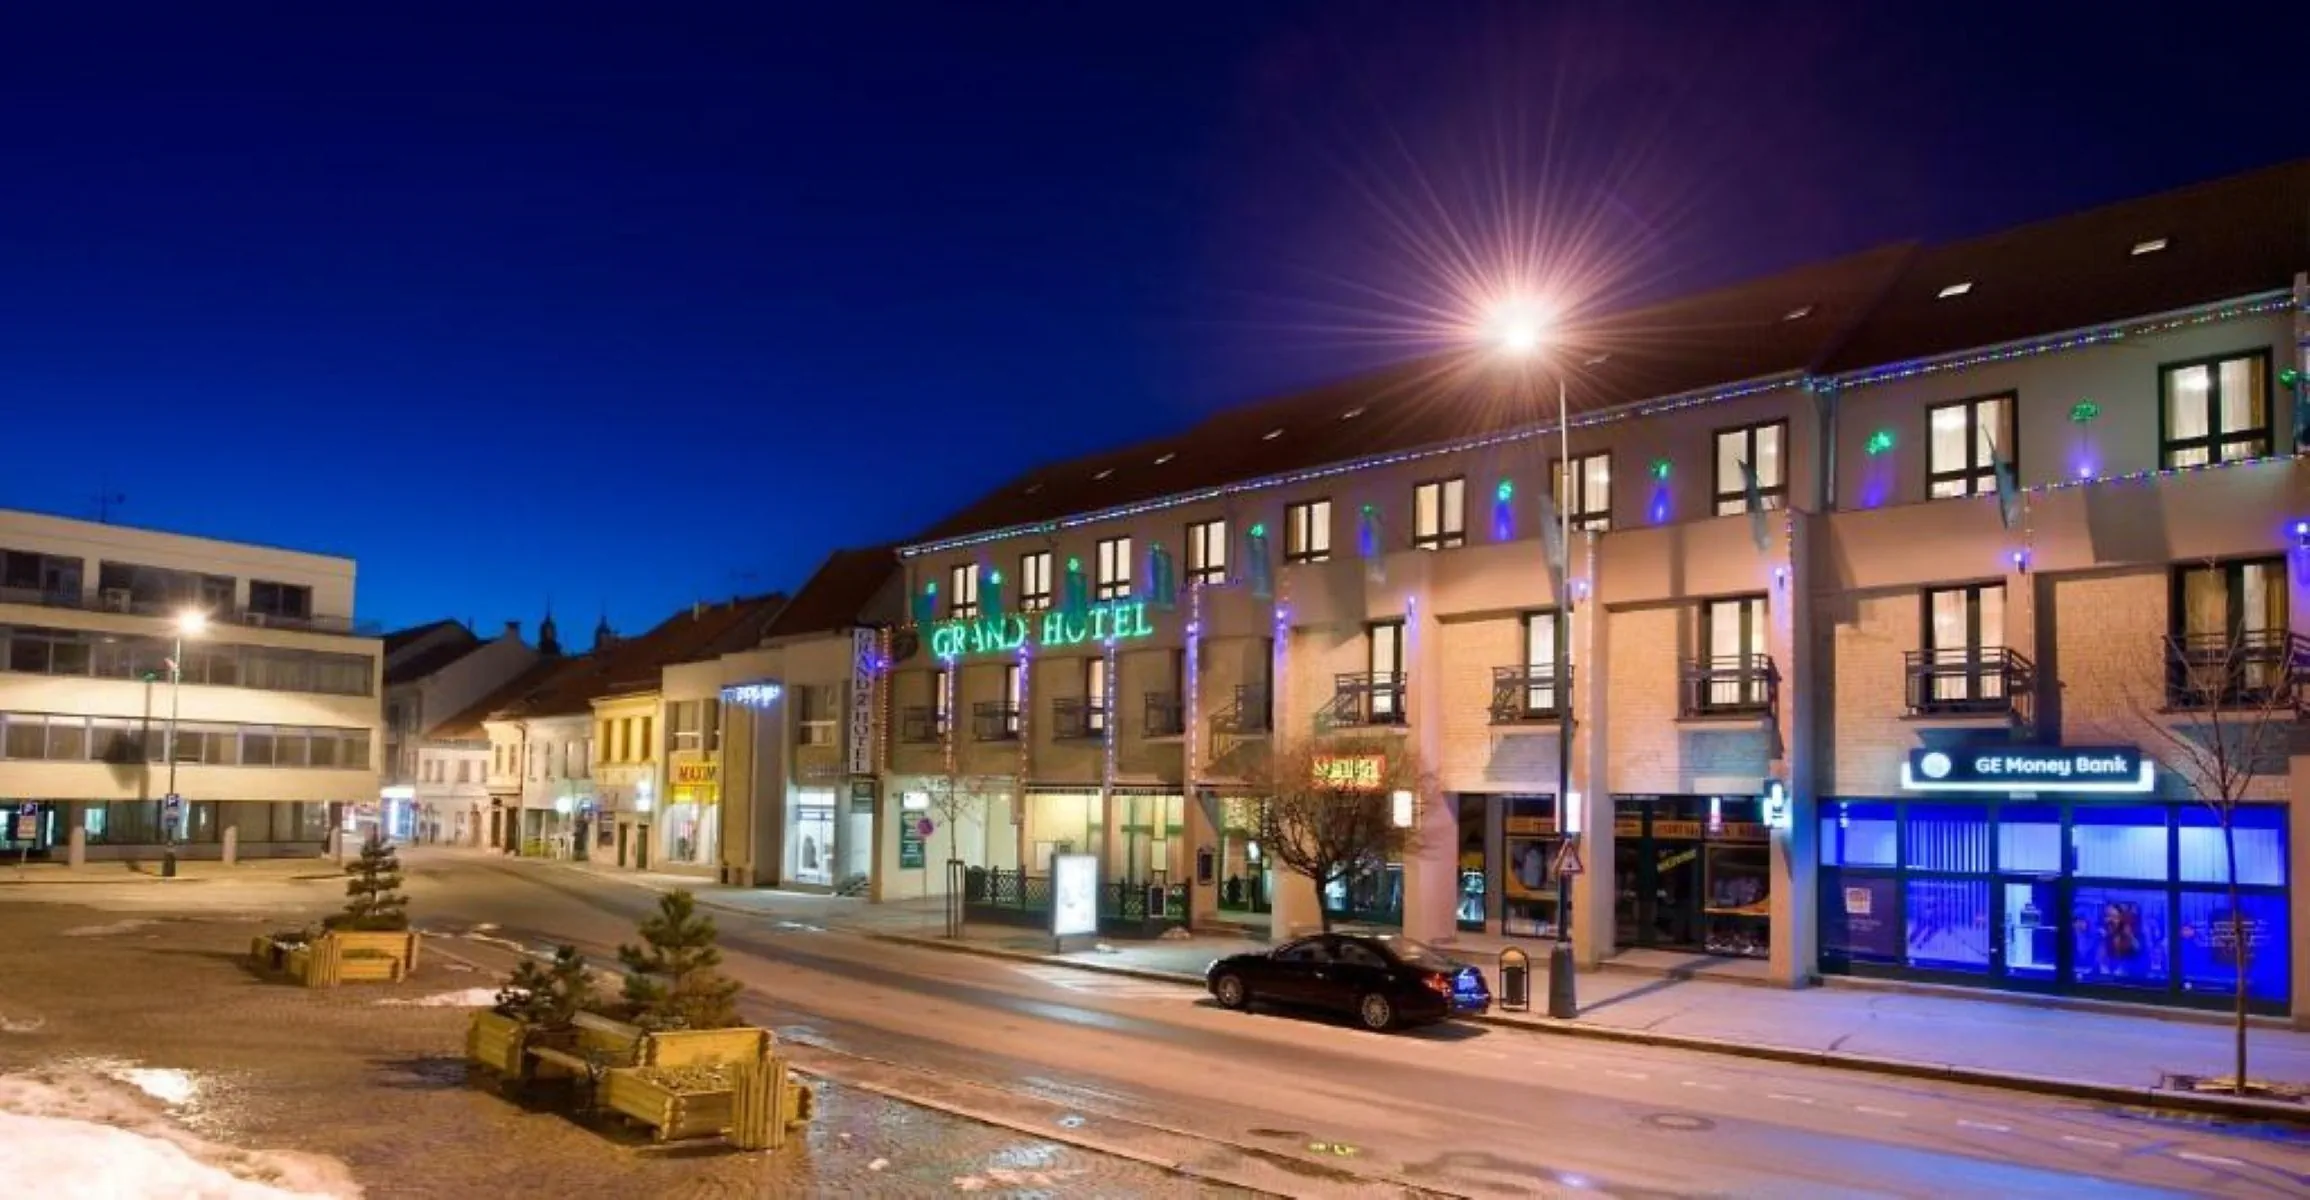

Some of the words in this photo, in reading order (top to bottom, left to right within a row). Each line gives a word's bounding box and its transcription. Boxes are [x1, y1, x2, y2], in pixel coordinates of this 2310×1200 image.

[932, 617, 1025, 658] GRAND
[1041, 602, 1154, 646] HOTEL
[1975, 756, 2003, 774] GE
[2004, 756, 2072, 777] Money
[2075, 754, 2128, 774] Bank
